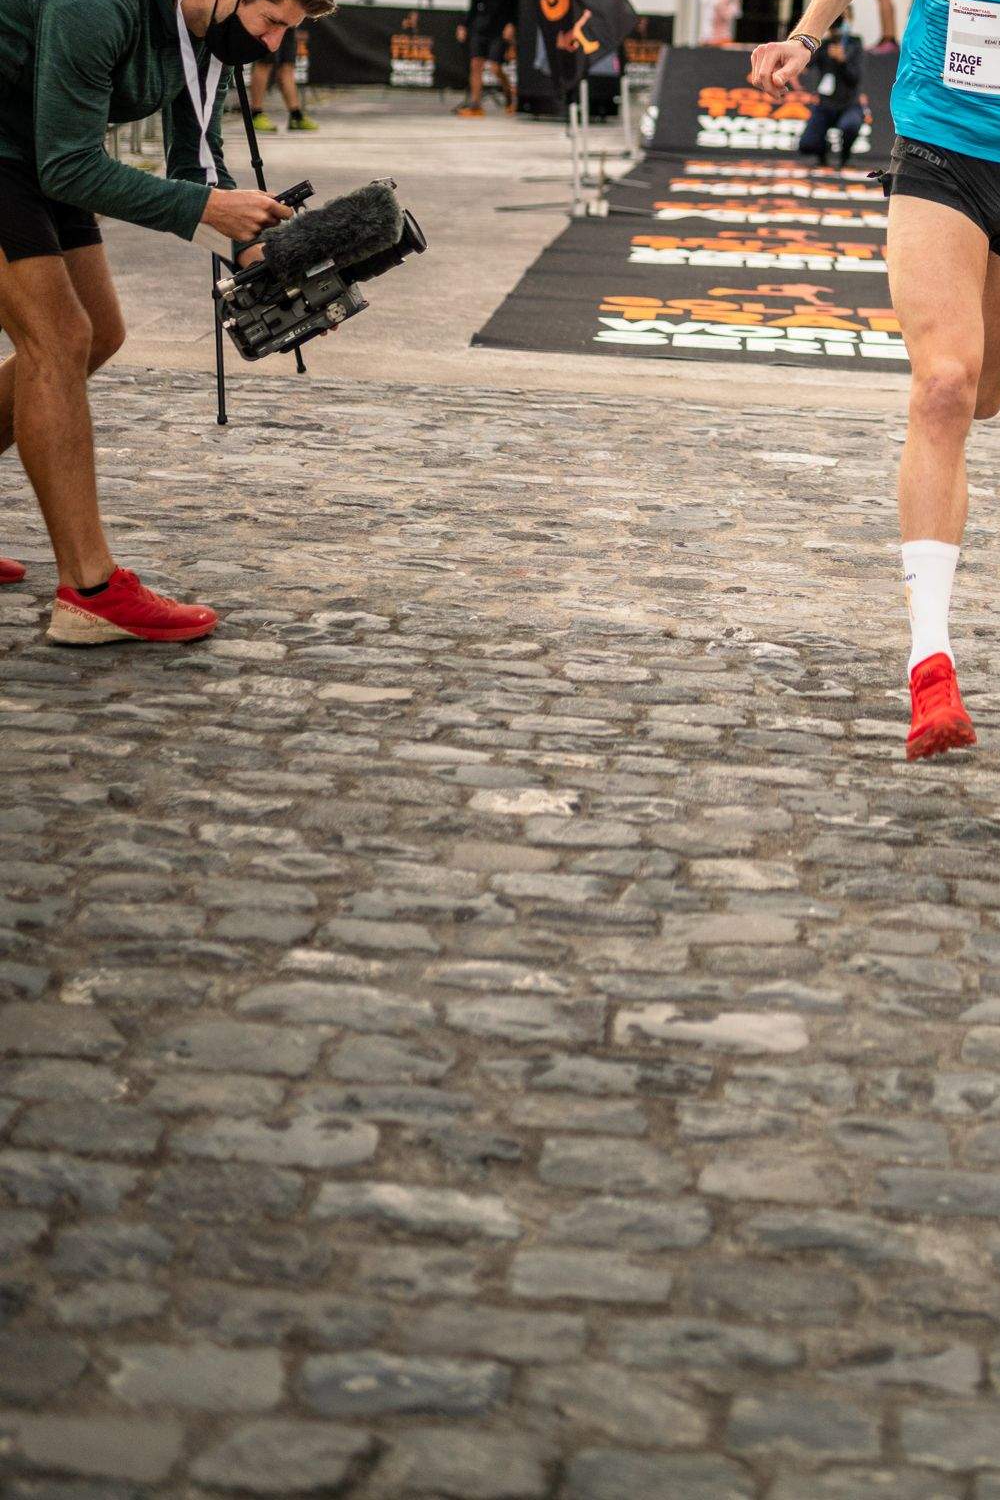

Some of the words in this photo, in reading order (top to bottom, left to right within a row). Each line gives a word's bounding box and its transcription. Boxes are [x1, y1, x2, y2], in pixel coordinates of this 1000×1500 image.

[950, 51, 982, 66] STAGE
[949, 64, 976, 76] RACE
[597, 316, 906, 345] WORL
[592, 329, 911, 360] SERIE
